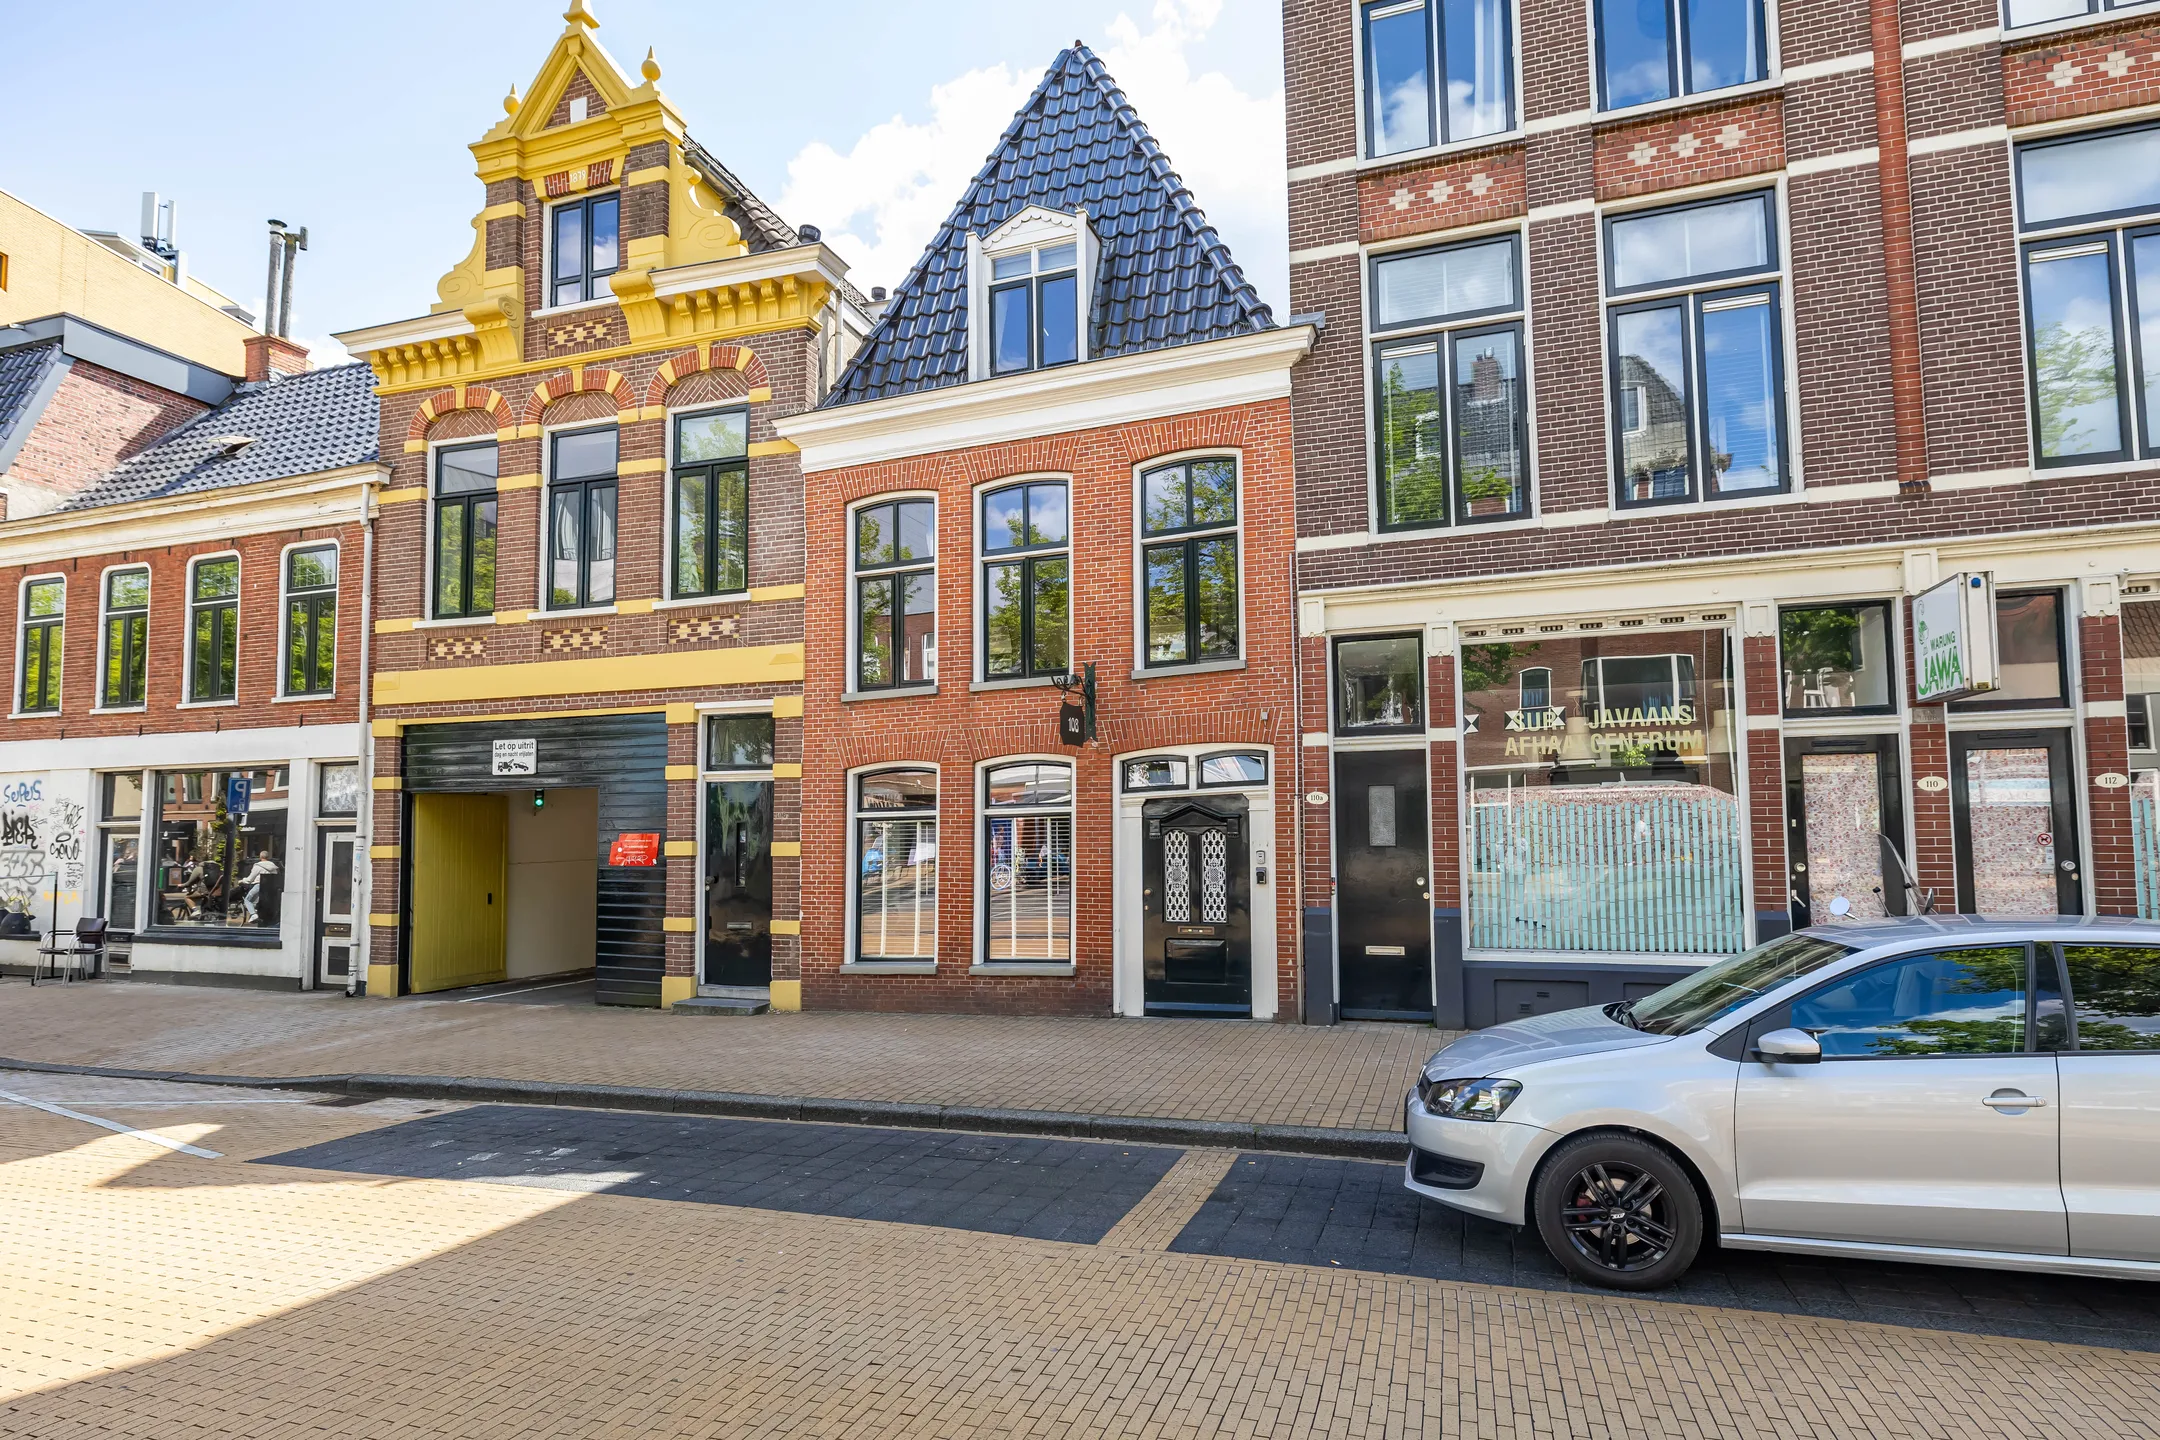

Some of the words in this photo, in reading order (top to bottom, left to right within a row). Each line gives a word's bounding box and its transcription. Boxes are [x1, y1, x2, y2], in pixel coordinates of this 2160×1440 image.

[570, 170, 586, 183] 1879
[1930, 631, 1956, 652] WARUNG
[1918, 645, 1963, 696] JAWA
[1068, 716, 1080, 733] 108
[1589, 705, 1692, 729] JAVAANS
[494, 742, 506, 750] Let
[507, 743, 517, 751] op
[517, 741, 534, 750] uitrit
[1590, 730, 1702, 753] CENTRUM
[1926, 780, 1938, 788] 110
[2104, 776, 2117, 784] 112
